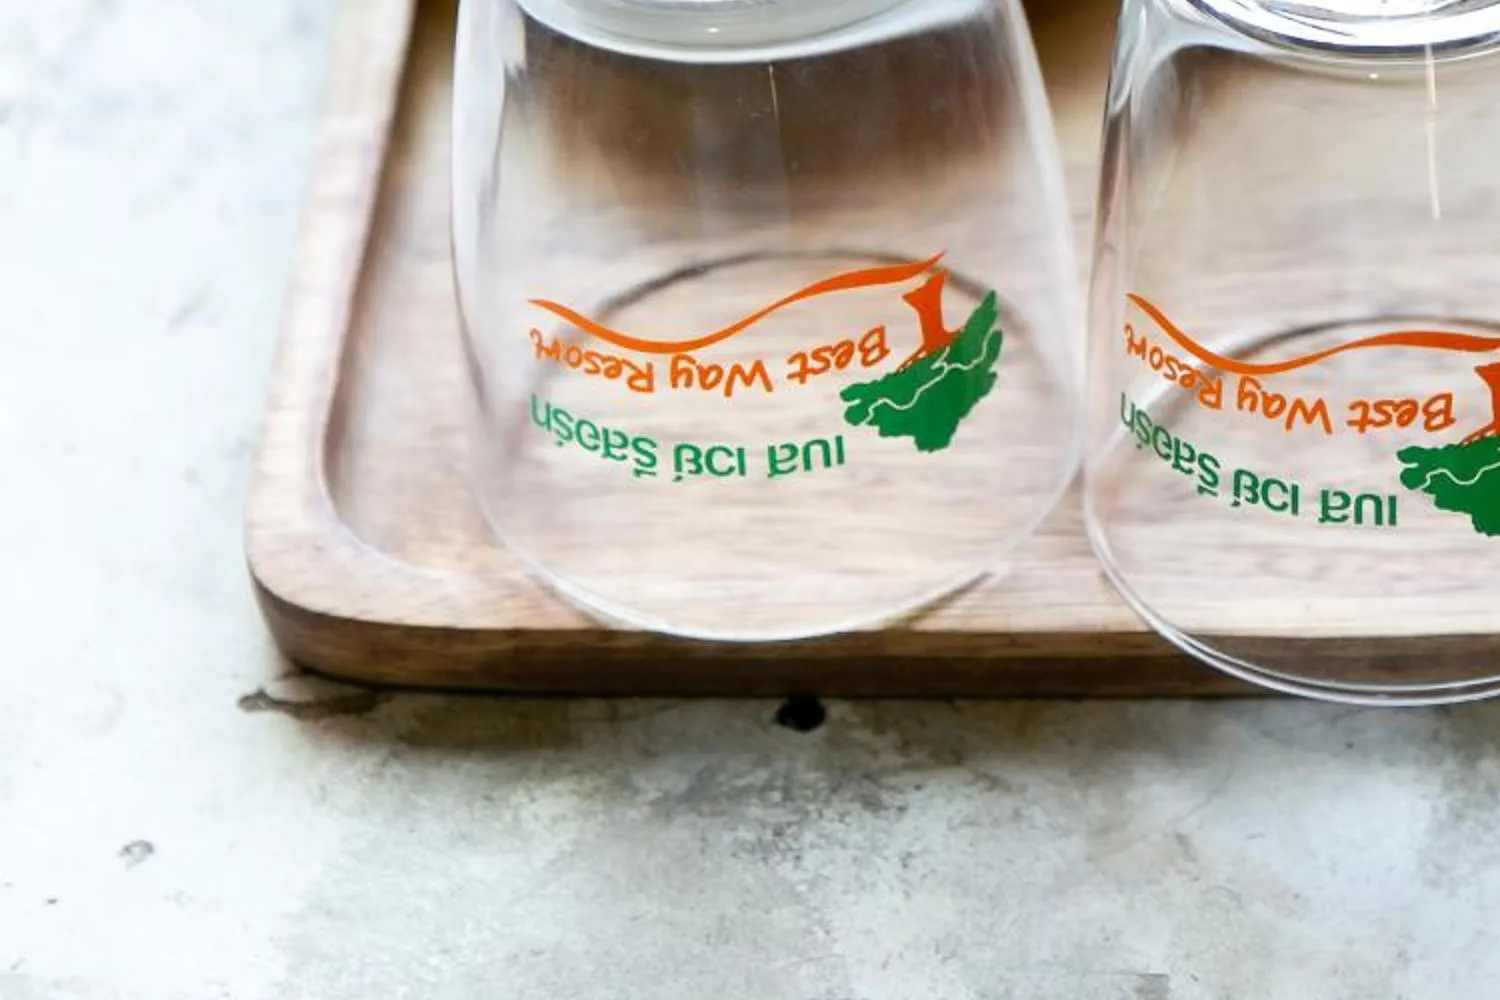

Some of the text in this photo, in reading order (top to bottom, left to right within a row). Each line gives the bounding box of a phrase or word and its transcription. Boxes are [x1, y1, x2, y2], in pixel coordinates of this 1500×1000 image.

[529, 325, 891, 397] Best Way Resort
[1124, 323, 1456, 434] Best Way Resort
[674, 443, 746, 482] เวย์
[768, 435, 845, 479] เบส
[1234, 468, 1299, 516] เวย์
[1319, 489, 1397, 526] เบส
